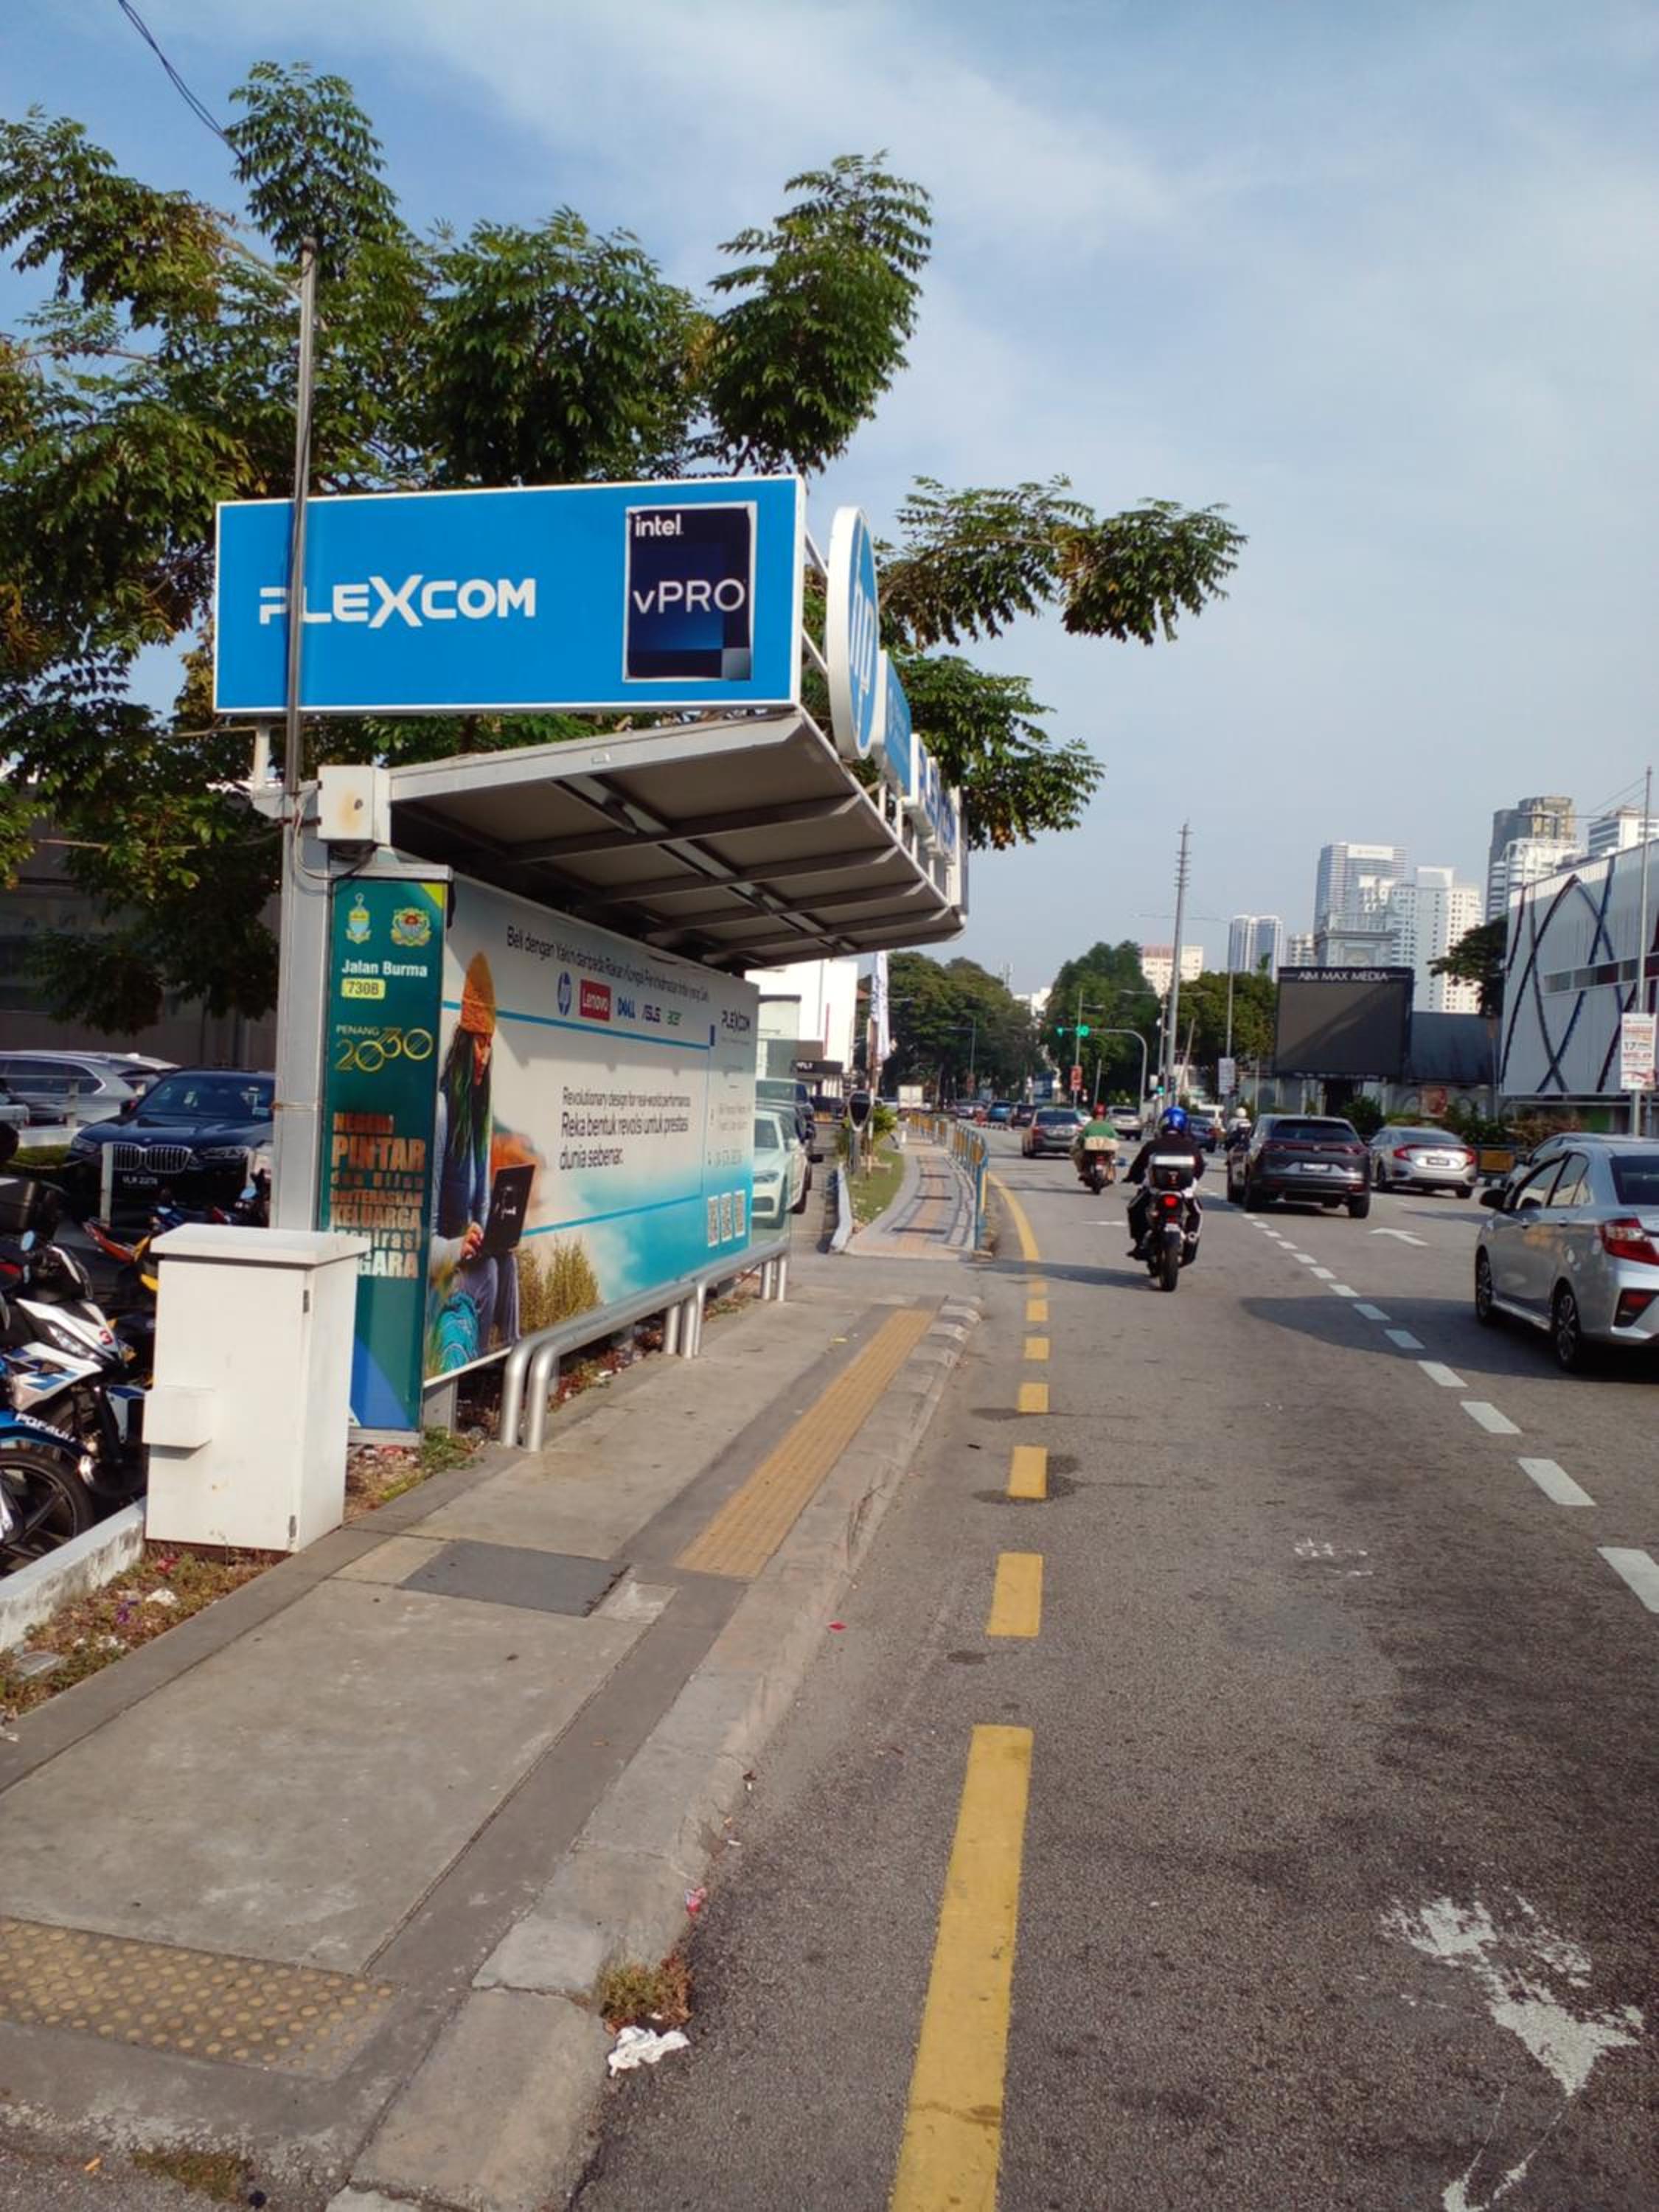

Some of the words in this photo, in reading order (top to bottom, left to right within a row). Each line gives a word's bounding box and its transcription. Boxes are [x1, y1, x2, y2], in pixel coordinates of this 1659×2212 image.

[260, 574, 536, 627] PLEXCOM
[633, 578, 745, 614] vPRO
[341, 959, 378, 974] Jalan
[383, 961, 428, 978] Burma
[1321, 971, 1347, 981] MAX
[1350, 971, 1388, 981] MEDIA
[336, 1024, 379, 1035] PENANG
[335, 1027, 434, 1072] 2030
[331, 1134, 425, 1171] PINTAR
[330, 1203, 421, 1229] KELUARGA
